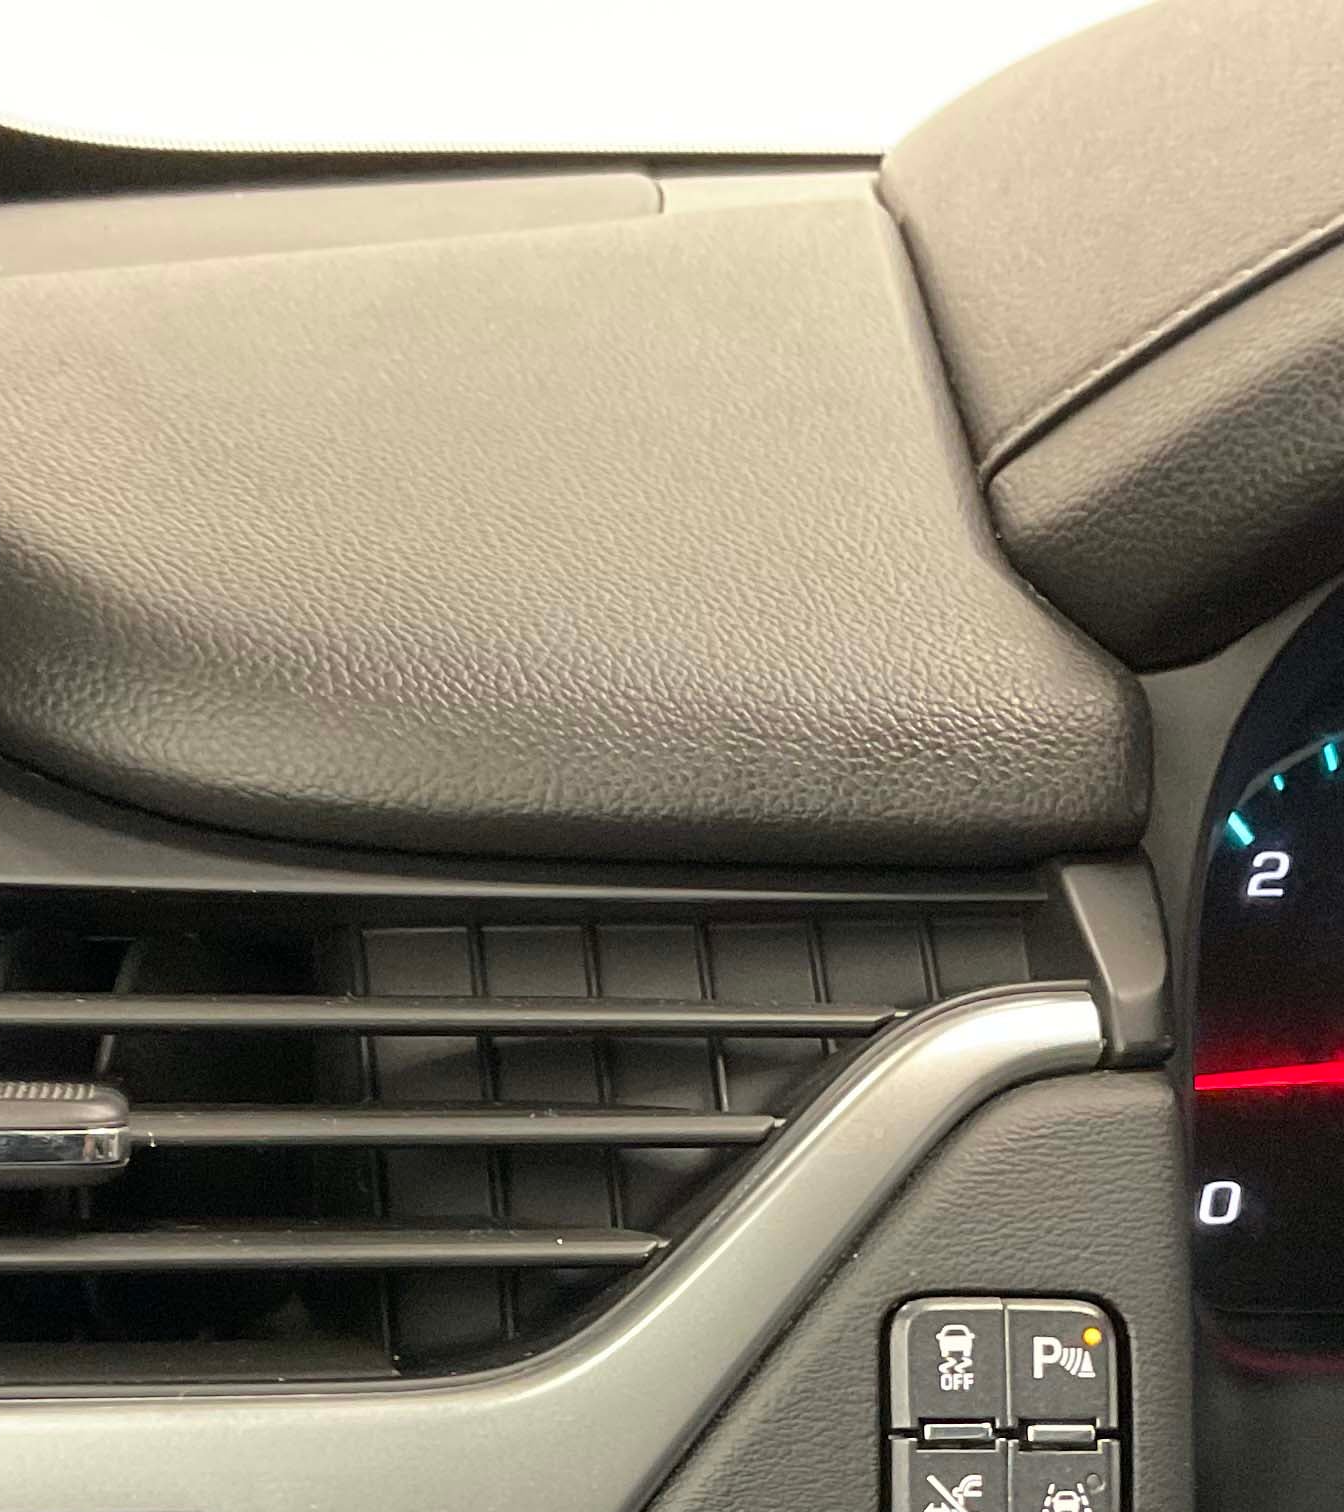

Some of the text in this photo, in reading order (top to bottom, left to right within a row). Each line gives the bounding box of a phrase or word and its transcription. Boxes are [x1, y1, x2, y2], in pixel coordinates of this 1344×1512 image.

[1247, 850, 1290, 897] 2
[1199, 1180, 1241, 1225] 0
[940, 1373, 974, 1391] OFF
